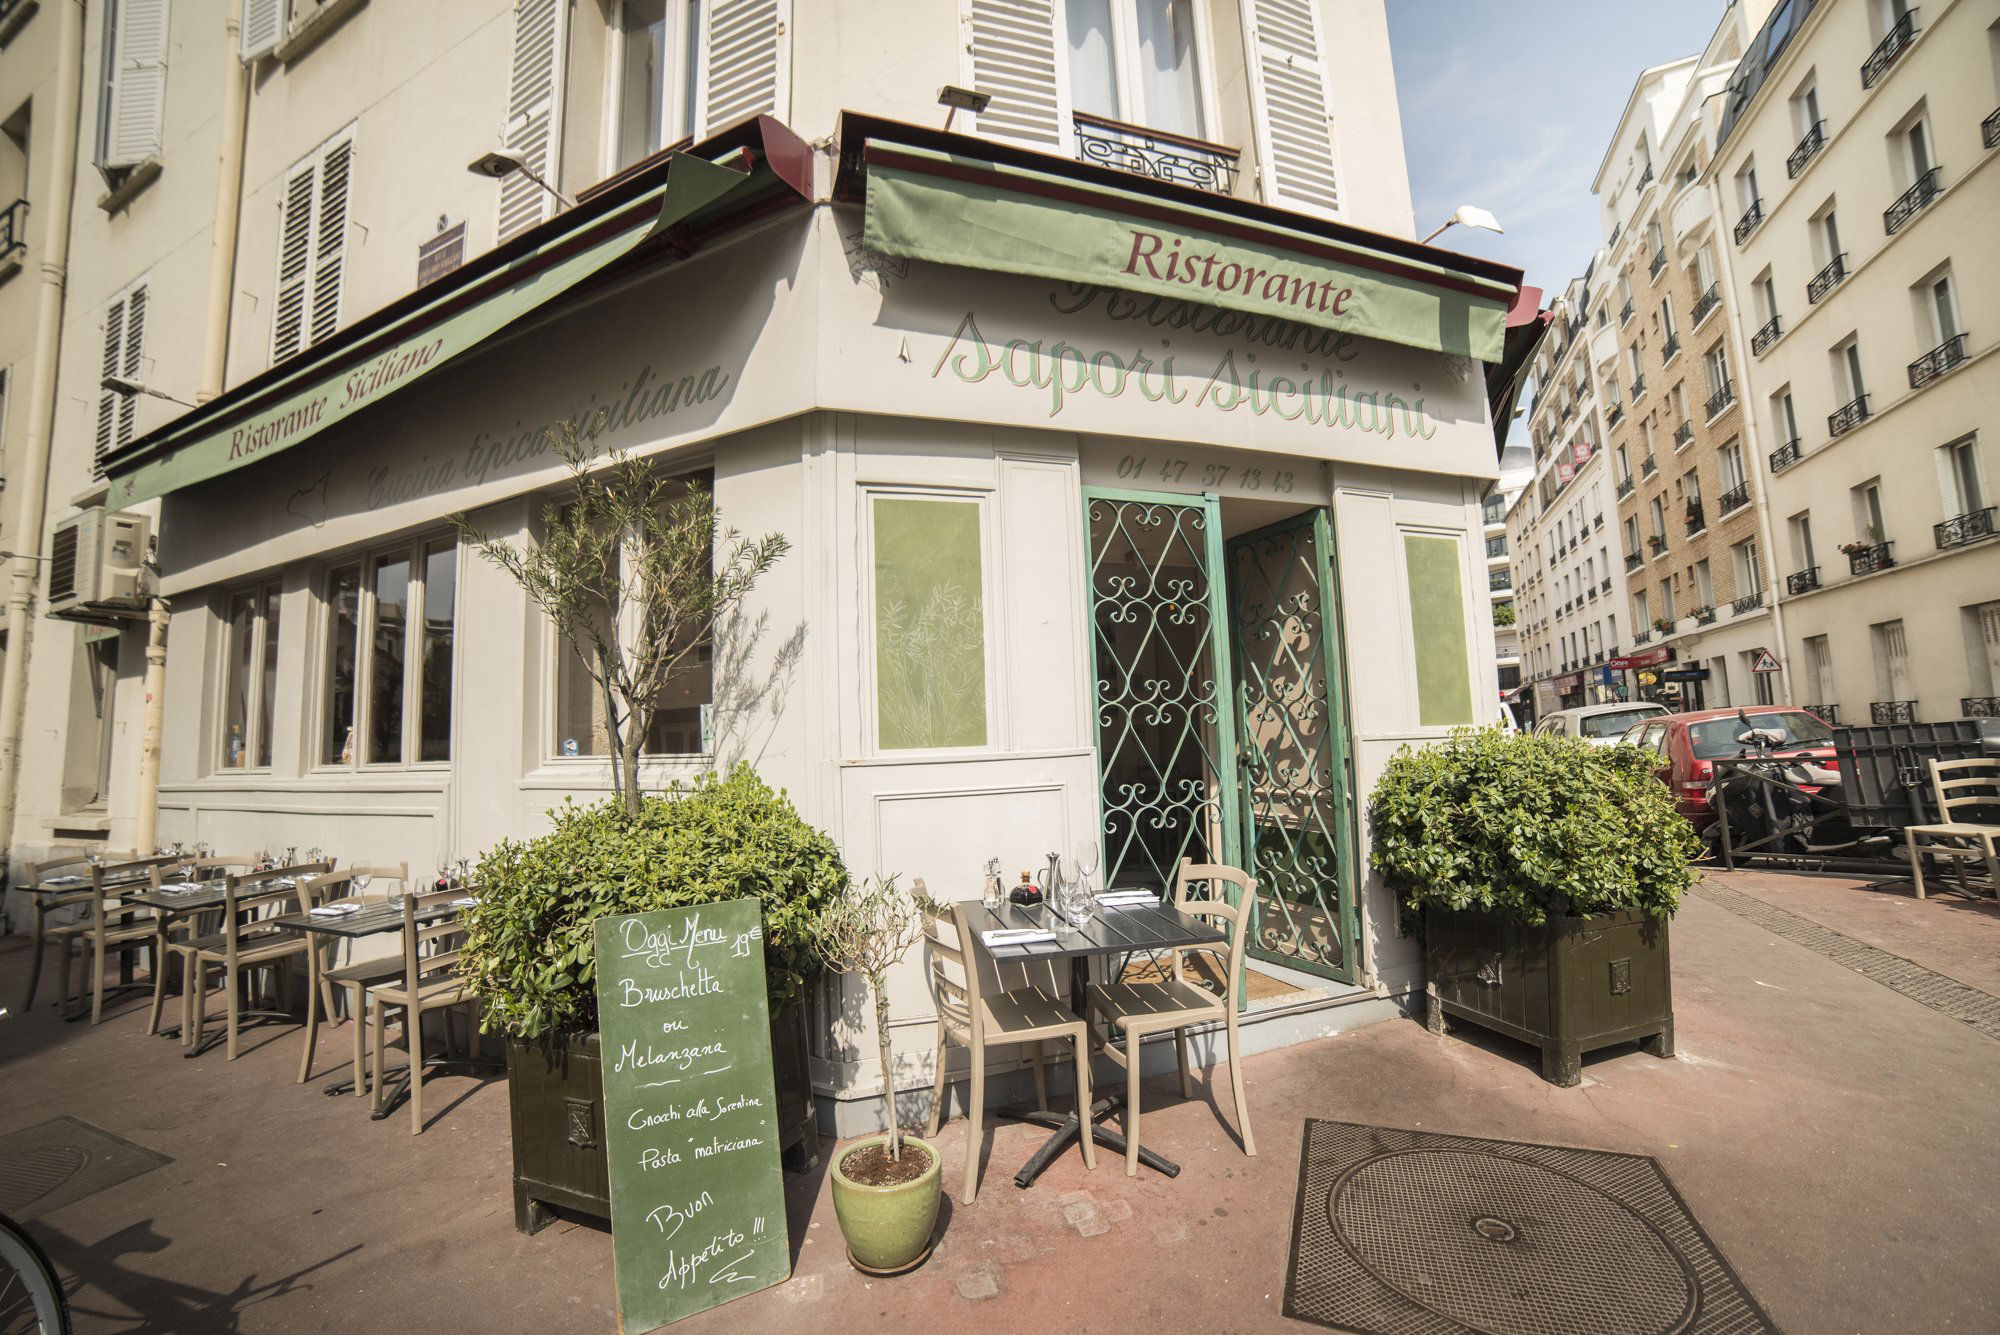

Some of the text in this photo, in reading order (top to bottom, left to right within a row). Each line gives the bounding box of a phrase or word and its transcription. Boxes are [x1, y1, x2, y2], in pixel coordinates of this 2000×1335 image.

[1119, 229, 1353, 318] Ristorante
[227, 338, 443, 462] Ristorante Siciliano
[931, 311, 1436, 442] Sapori Siciliani
[461, 419, 552, 487] tipica
[1116, 455, 1294, 494] 01 47 37 13 43
[619, 918, 677, 968] Oggi
[679, 911, 727, 969] Menu
[618, 967, 724, 1007] Bruschetta
[663, 1020, 688, 1033] ou
[614, 1039, 727, 1073] Melanzana
[686, 1098, 711, 1118] alla
[710, 1094, 763, 1121] Sorentina
[638, 1148, 682, 1171] Pasta
[646, 1191, 714, 1241] Buon
[659, 1229, 744, 1289] Appetito
